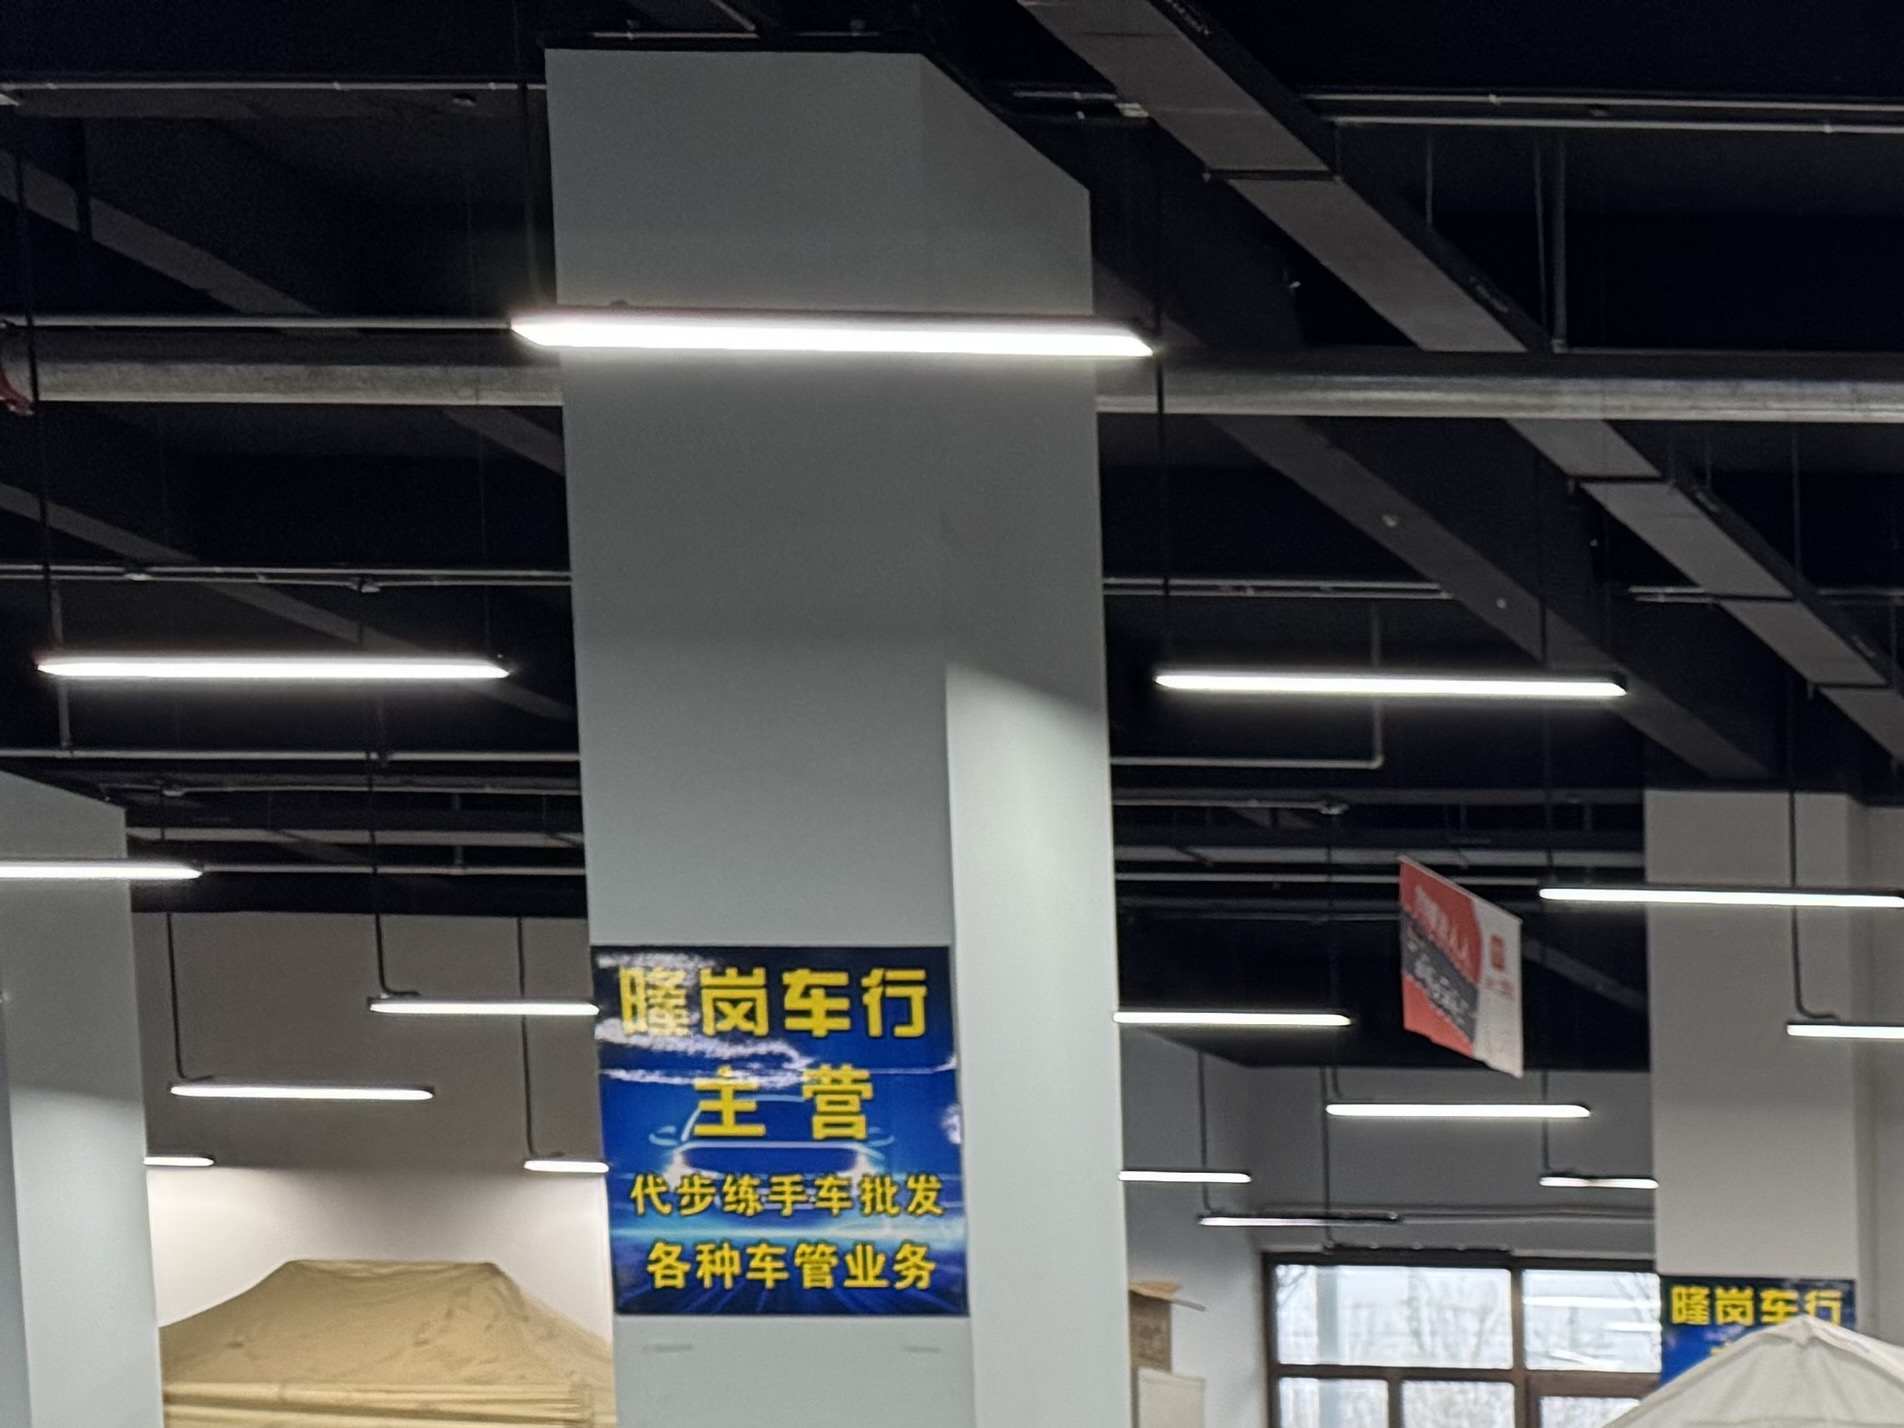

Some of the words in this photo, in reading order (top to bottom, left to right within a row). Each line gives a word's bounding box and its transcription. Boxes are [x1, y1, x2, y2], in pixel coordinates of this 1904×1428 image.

[618, 965, 928, 1039] 隆岗车行
[692, 1064, 874, 1141] 主营
[630, 1172, 946, 1217] 代步练手车批发
[646, 1239, 938, 1291] 各种车管业务
[1671, 1285, 1843, 1328] 隆岗车行
